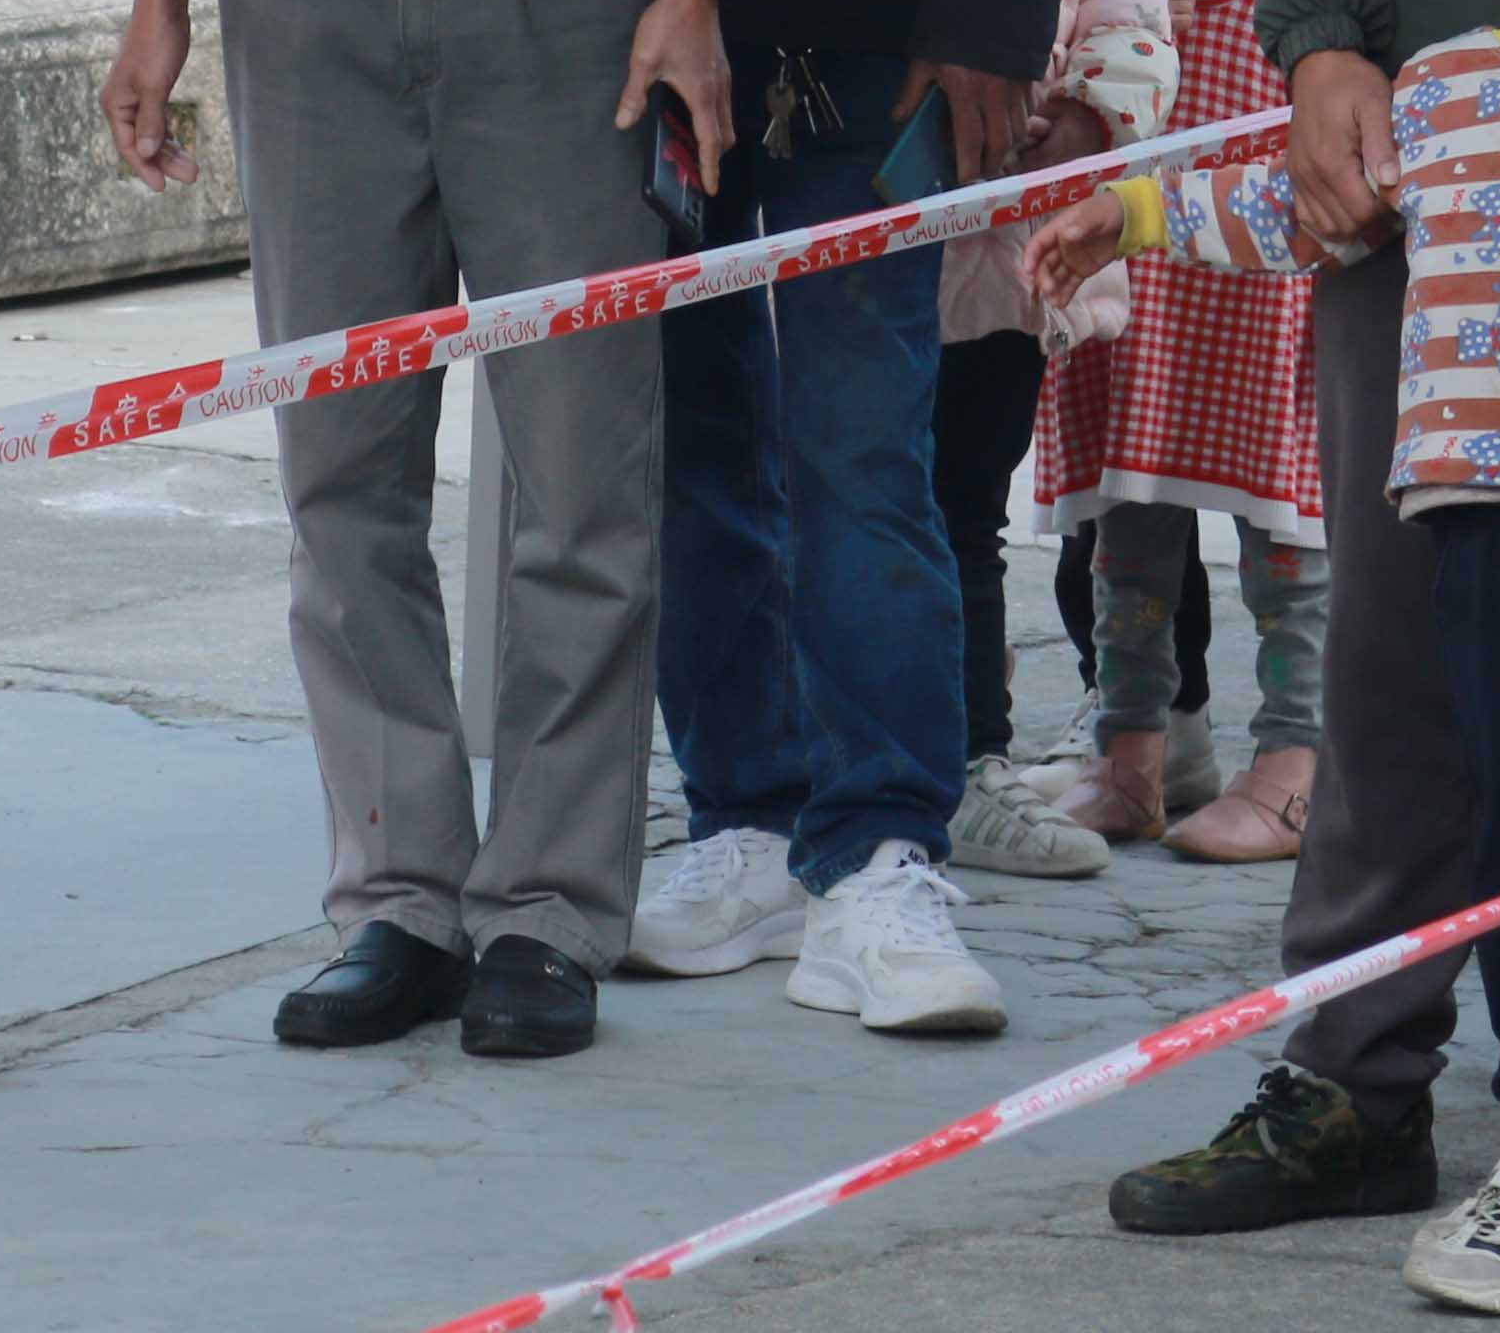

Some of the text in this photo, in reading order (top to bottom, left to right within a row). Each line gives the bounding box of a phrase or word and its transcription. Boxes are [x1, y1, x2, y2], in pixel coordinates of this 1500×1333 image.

[73, 403, 164, 448] SAFE
[200, 374, 296, 418] CAUTION
[329, 345, 413, 388] SAFE
[447, 316, 539, 358] CAUTION
[571, 289, 650, 330] SAFE
[681, 264, 767, 301] CAUTION
[798, 240, 872, 272] SAFE
